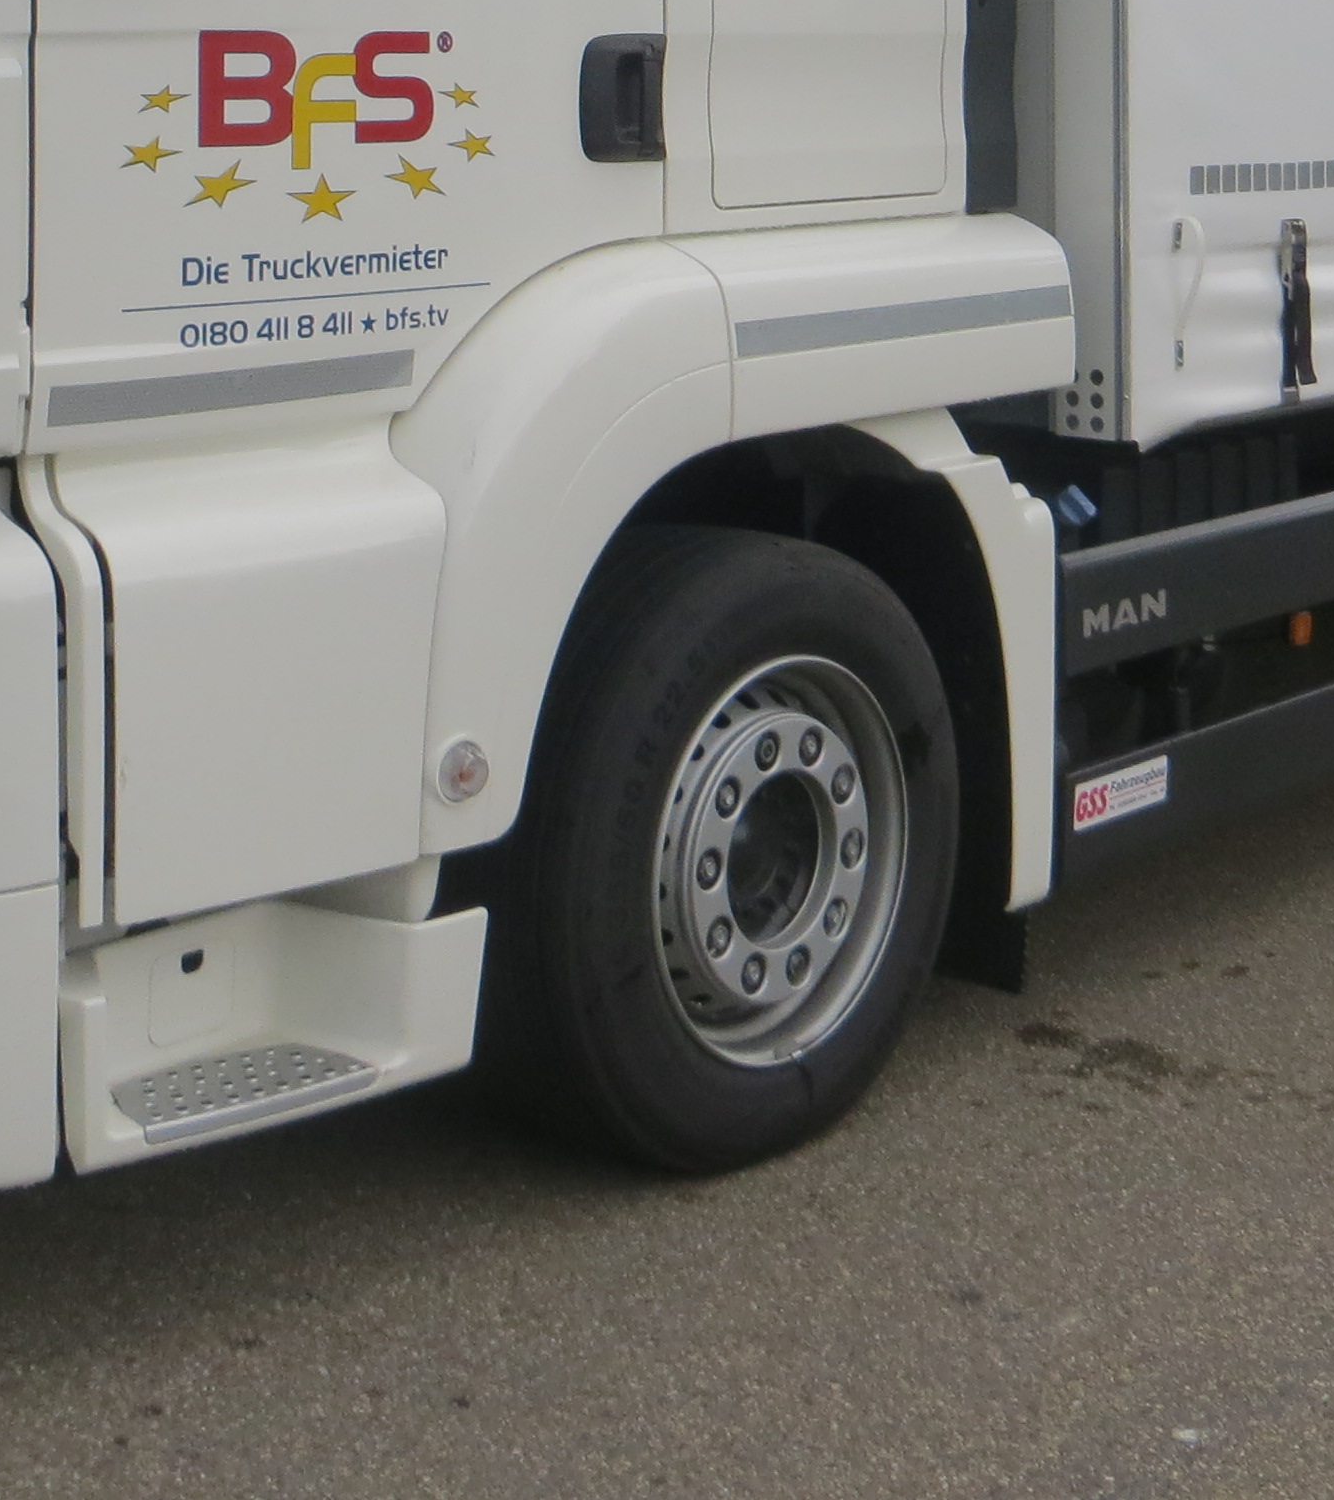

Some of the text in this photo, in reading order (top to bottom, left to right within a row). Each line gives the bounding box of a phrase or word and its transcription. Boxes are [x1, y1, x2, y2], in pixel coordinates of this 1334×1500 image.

[199, 31, 433, 169] BfS
[182, 245, 448, 286] Die Truckvermieter
[181, 305, 449, 348] 0180 411 8 411 bfs.tv
[1083, 589, 1166, 638] MAN
[1076, 784, 1108, 821] GSS
